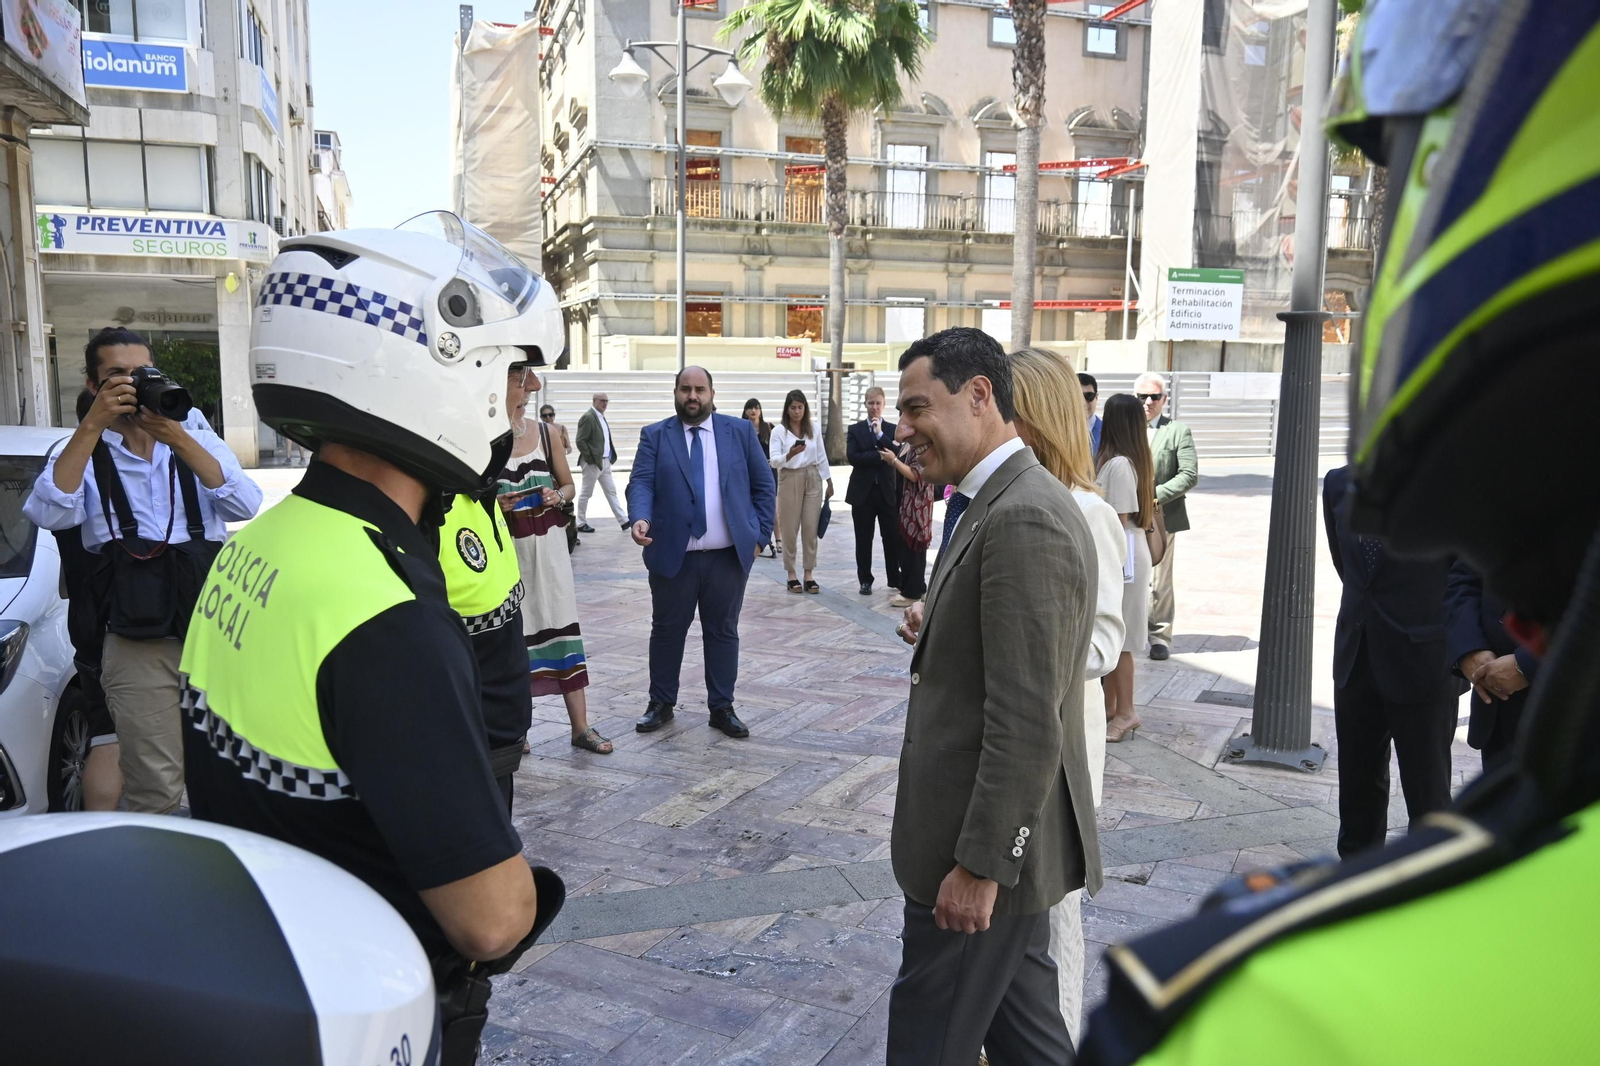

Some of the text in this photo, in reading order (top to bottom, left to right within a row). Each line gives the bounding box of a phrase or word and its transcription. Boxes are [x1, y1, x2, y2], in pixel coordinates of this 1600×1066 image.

[82, 50, 177, 76] iolanum
[144, 53, 176, 62] BANCO
[76, 216, 226, 236] PREVENTIVA
[132, 239, 227, 256] SEGUROS
[239, 242, 268, 250] PREVENTIVA
[1172, 286, 1226, 296] Terminación
[1171, 298, 1233, 308] Rehabilitación
[140, 307, 213, 326] cajamar
[1170, 309, 1202, 318] Edificio
[1170, 321, 1234, 331] Administrativo
[216, 540, 279, 609] OLICIA
[197, 578, 250, 651] LOCAL
